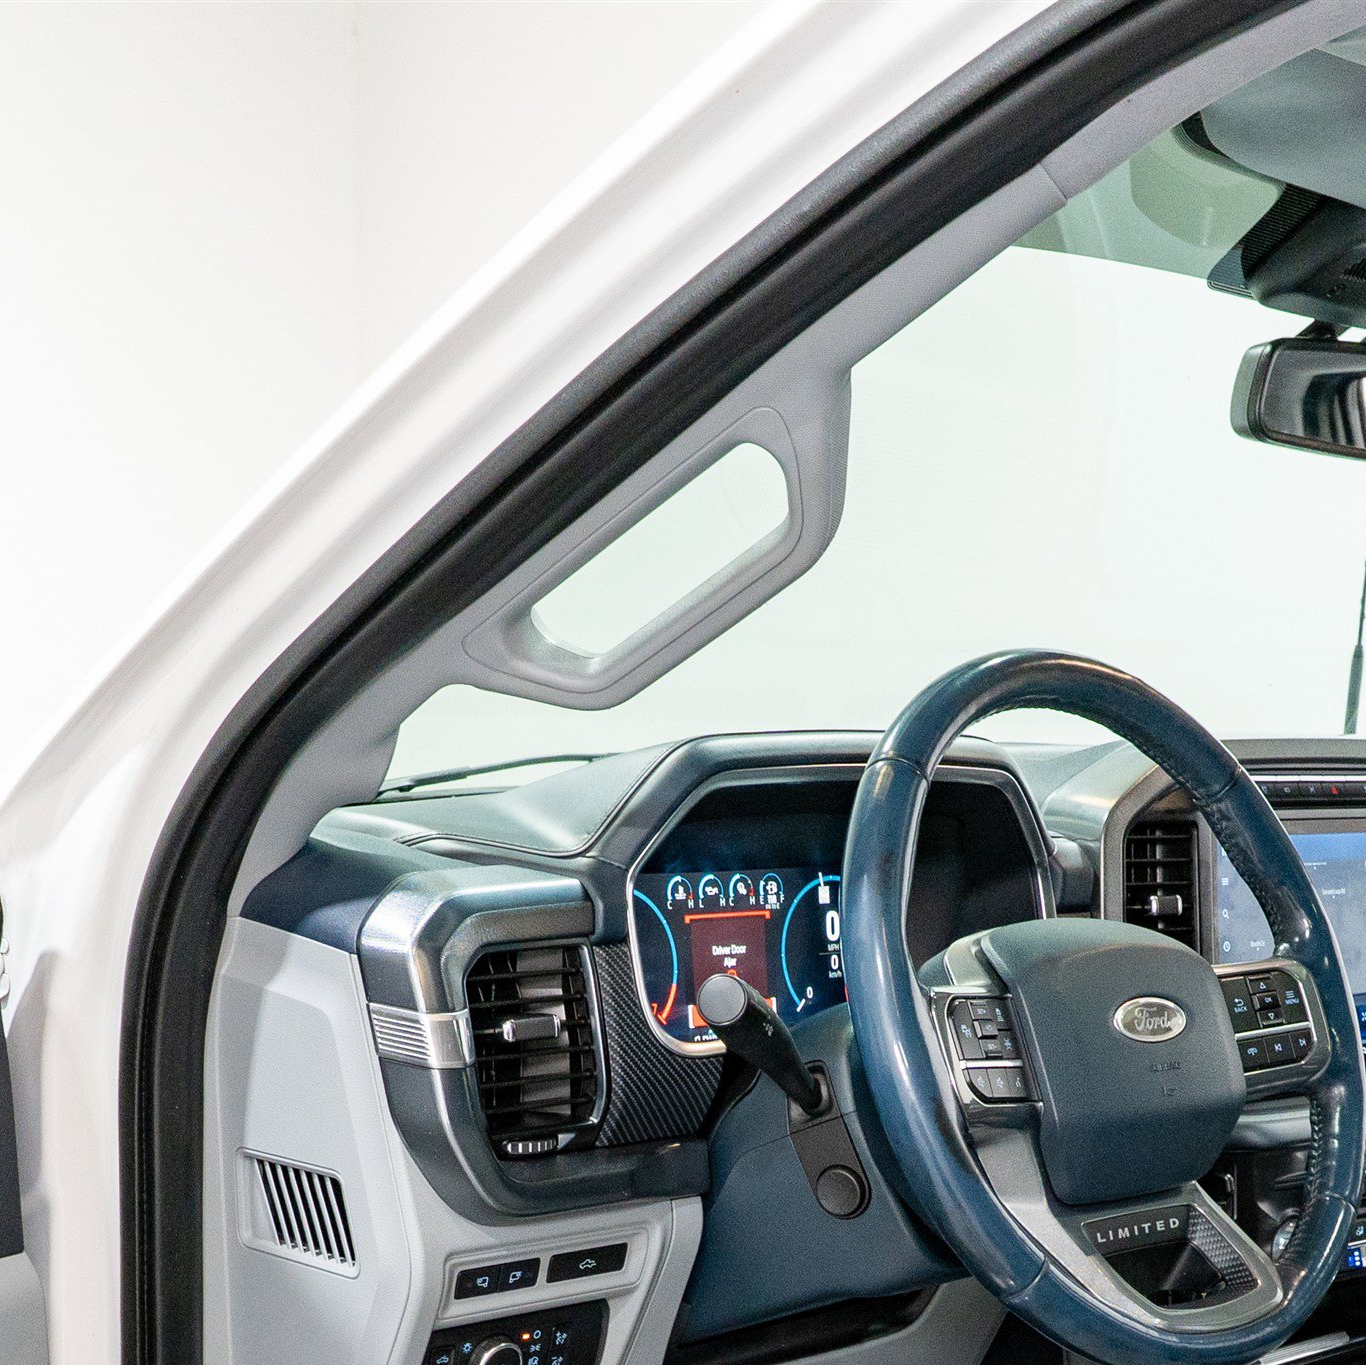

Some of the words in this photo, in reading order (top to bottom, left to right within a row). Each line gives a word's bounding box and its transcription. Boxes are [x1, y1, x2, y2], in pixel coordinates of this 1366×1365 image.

[688, 899, 694, 908] H
[719, 898, 726, 907] H
[749, 897, 755, 906] H
[759, 896, 765, 905] E
[826, 910, 840, 941] 0
[712, 945, 731, 956] Driver
[731, 944, 747, 954] Door
[830, 954, 839, 970] 0
[806, 986, 813, 999] 0
[1134, 1006, 1172, 1032] Ford
[1096, 1218, 1180, 1243] LIMITED
